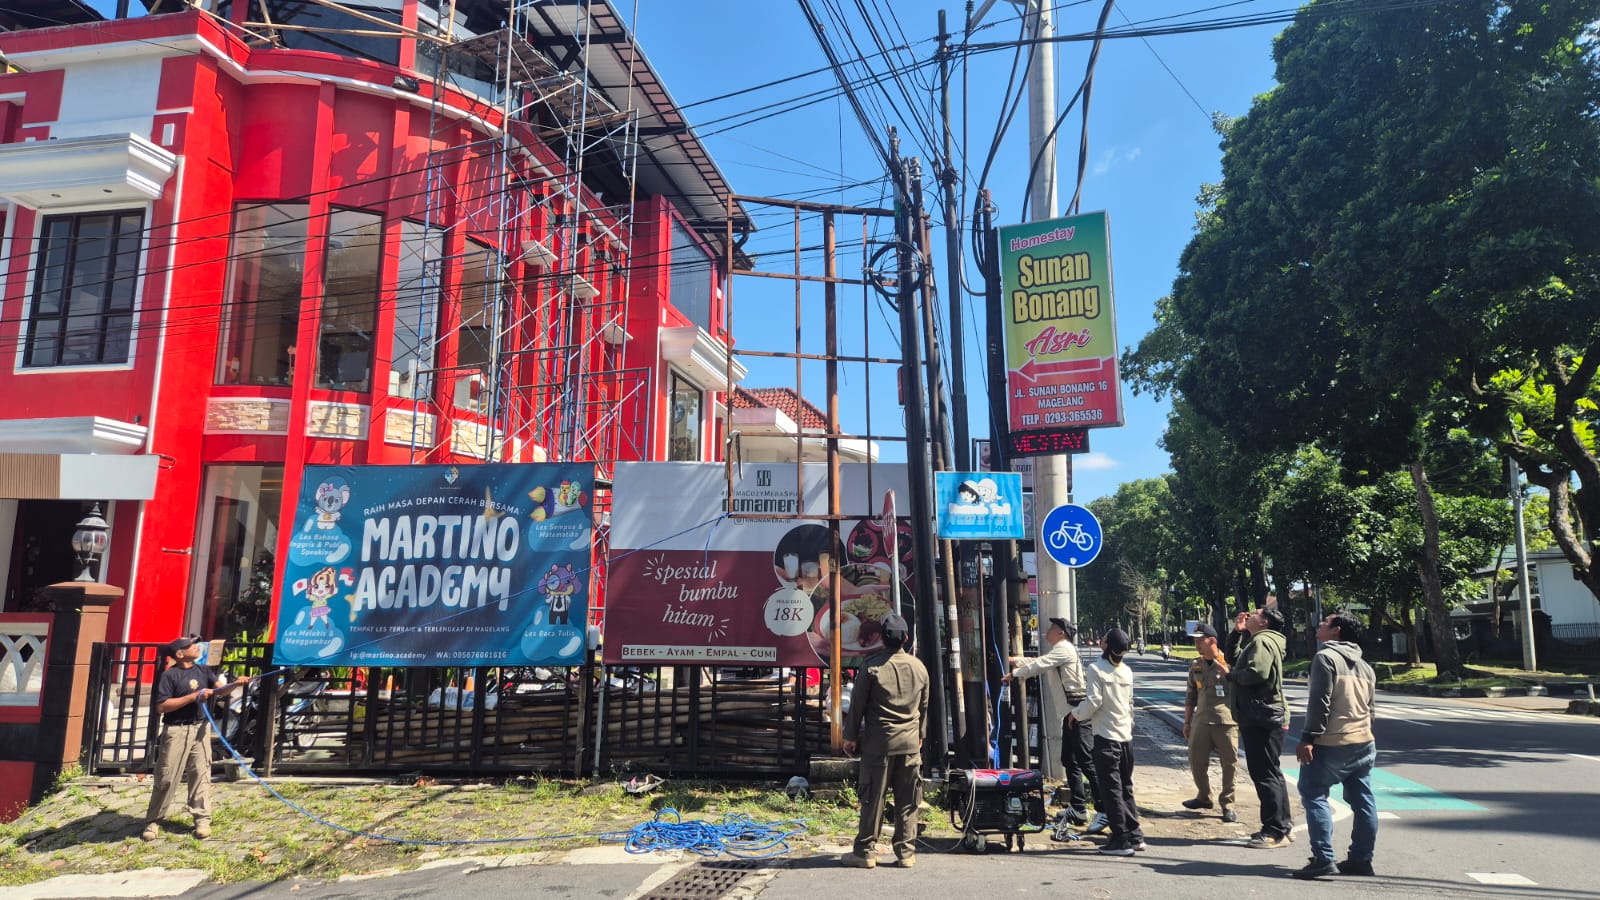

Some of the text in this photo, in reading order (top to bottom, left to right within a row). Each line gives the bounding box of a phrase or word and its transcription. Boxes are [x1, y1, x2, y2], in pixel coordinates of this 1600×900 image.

[1010, 226, 1075, 252] Homestay
[1018, 251, 1091, 288] Sunan
[1012, 285, 1100, 324] Bonang
[1024, 325, 1092, 356] Asri
[1014, 380, 1108, 399] JL. SUNAN BONANG 16
[1038, 396, 1084, 409] MAGELANG
[1021, 409, 1103, 425] TELP. 0293-365536
[363, 496, 520, 516] RAIH MASA DEPAN CERAH BERSAMA
[361, 514, 520, 562] MARTINO
[654, 560, 717, 584] spesial
[353, 564, 511, 611] ACADEMY
[679, 581, 738, 602] bumbu
[662, 604, 715, 627] hitam
[773, 607, 804, 621] 18K
[375, 625, 388, 633] LES
[474, 625, 510, 633] MAGELANG
